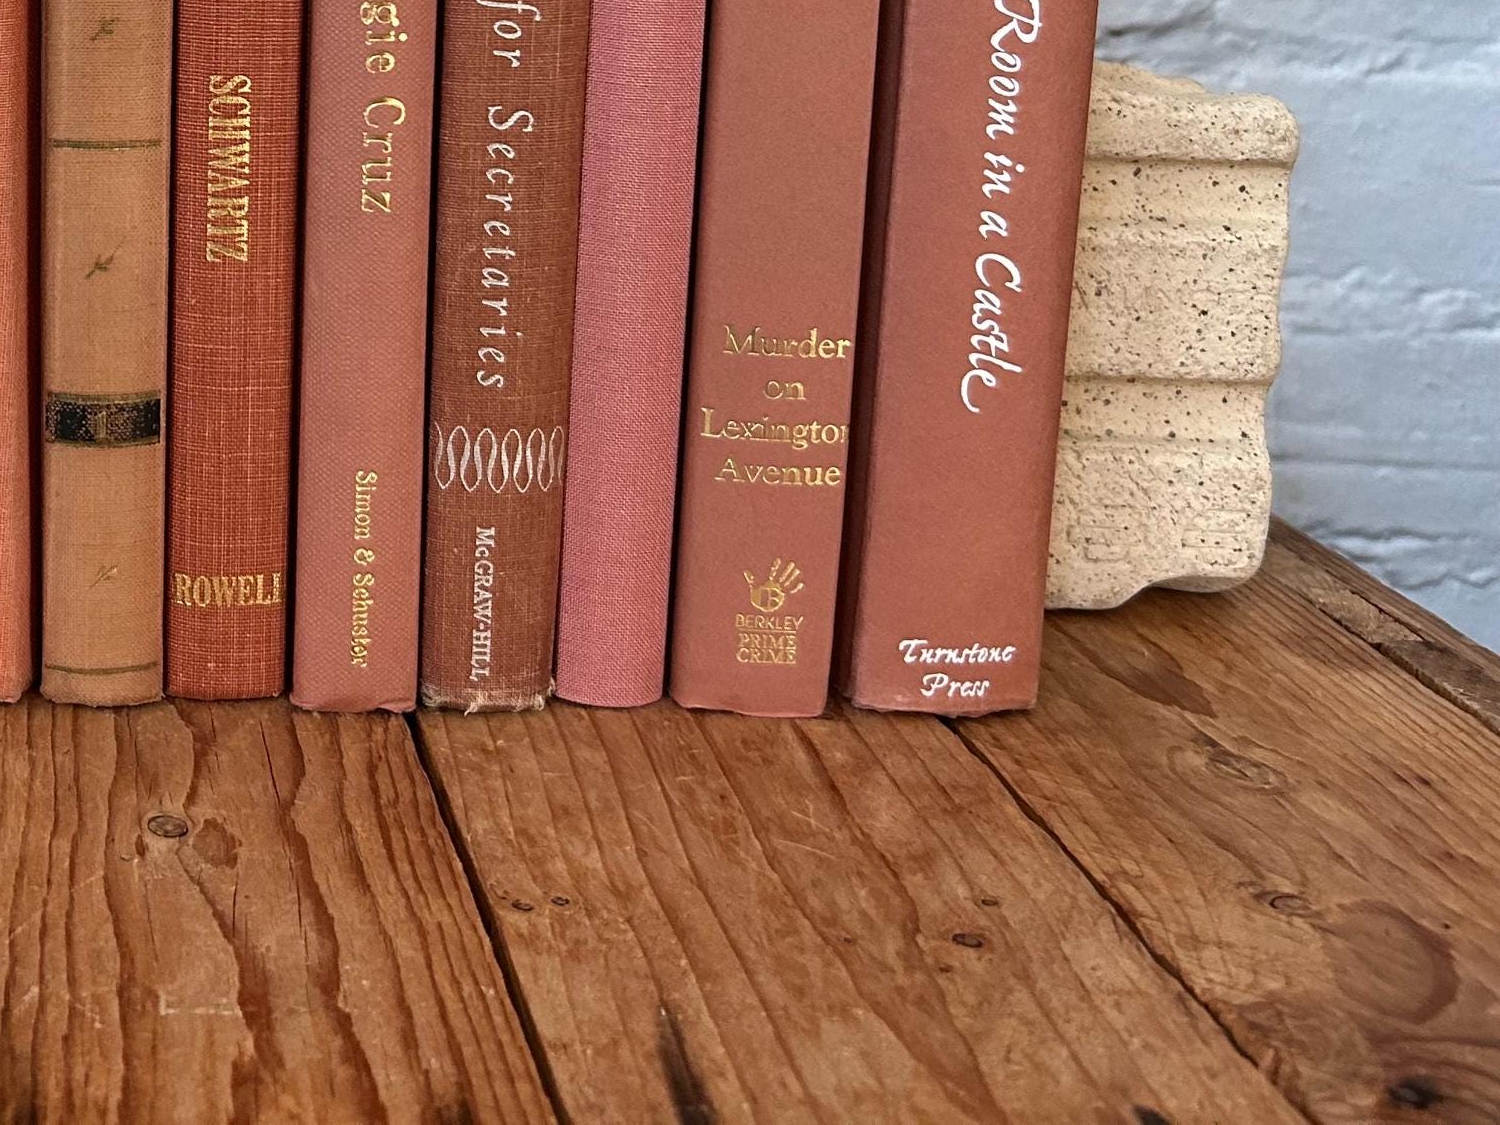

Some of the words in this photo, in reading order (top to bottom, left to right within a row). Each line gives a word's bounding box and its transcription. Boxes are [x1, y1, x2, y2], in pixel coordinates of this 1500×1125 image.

[205, 75, 253, 263] SCHWARTZ
[359, 95, 407, 216] Cruz
[982, 151, 1026, 199] in
[978, 210, 1009, 239] a
[476, 105, 535, 389] Secretaries
[722, 324, 852, 359] Murder
[959, 252, 1023, 415] Castle
[763, 379, 806, 401] on
[713, 457, 841, 486] Avenue
[354, 469, 378, 540] Simon
[354, 547, 375, 566] &
[350, 573, 375, 669] Schuster
[735, 613, 804, 630] BERKLEY
[738, 633, 798, 649] PRIME
[898, 638, 1016, 664] Turnstone
[736, 648, 797, 664] CRIME
[920, 671, 990, 697] Press
